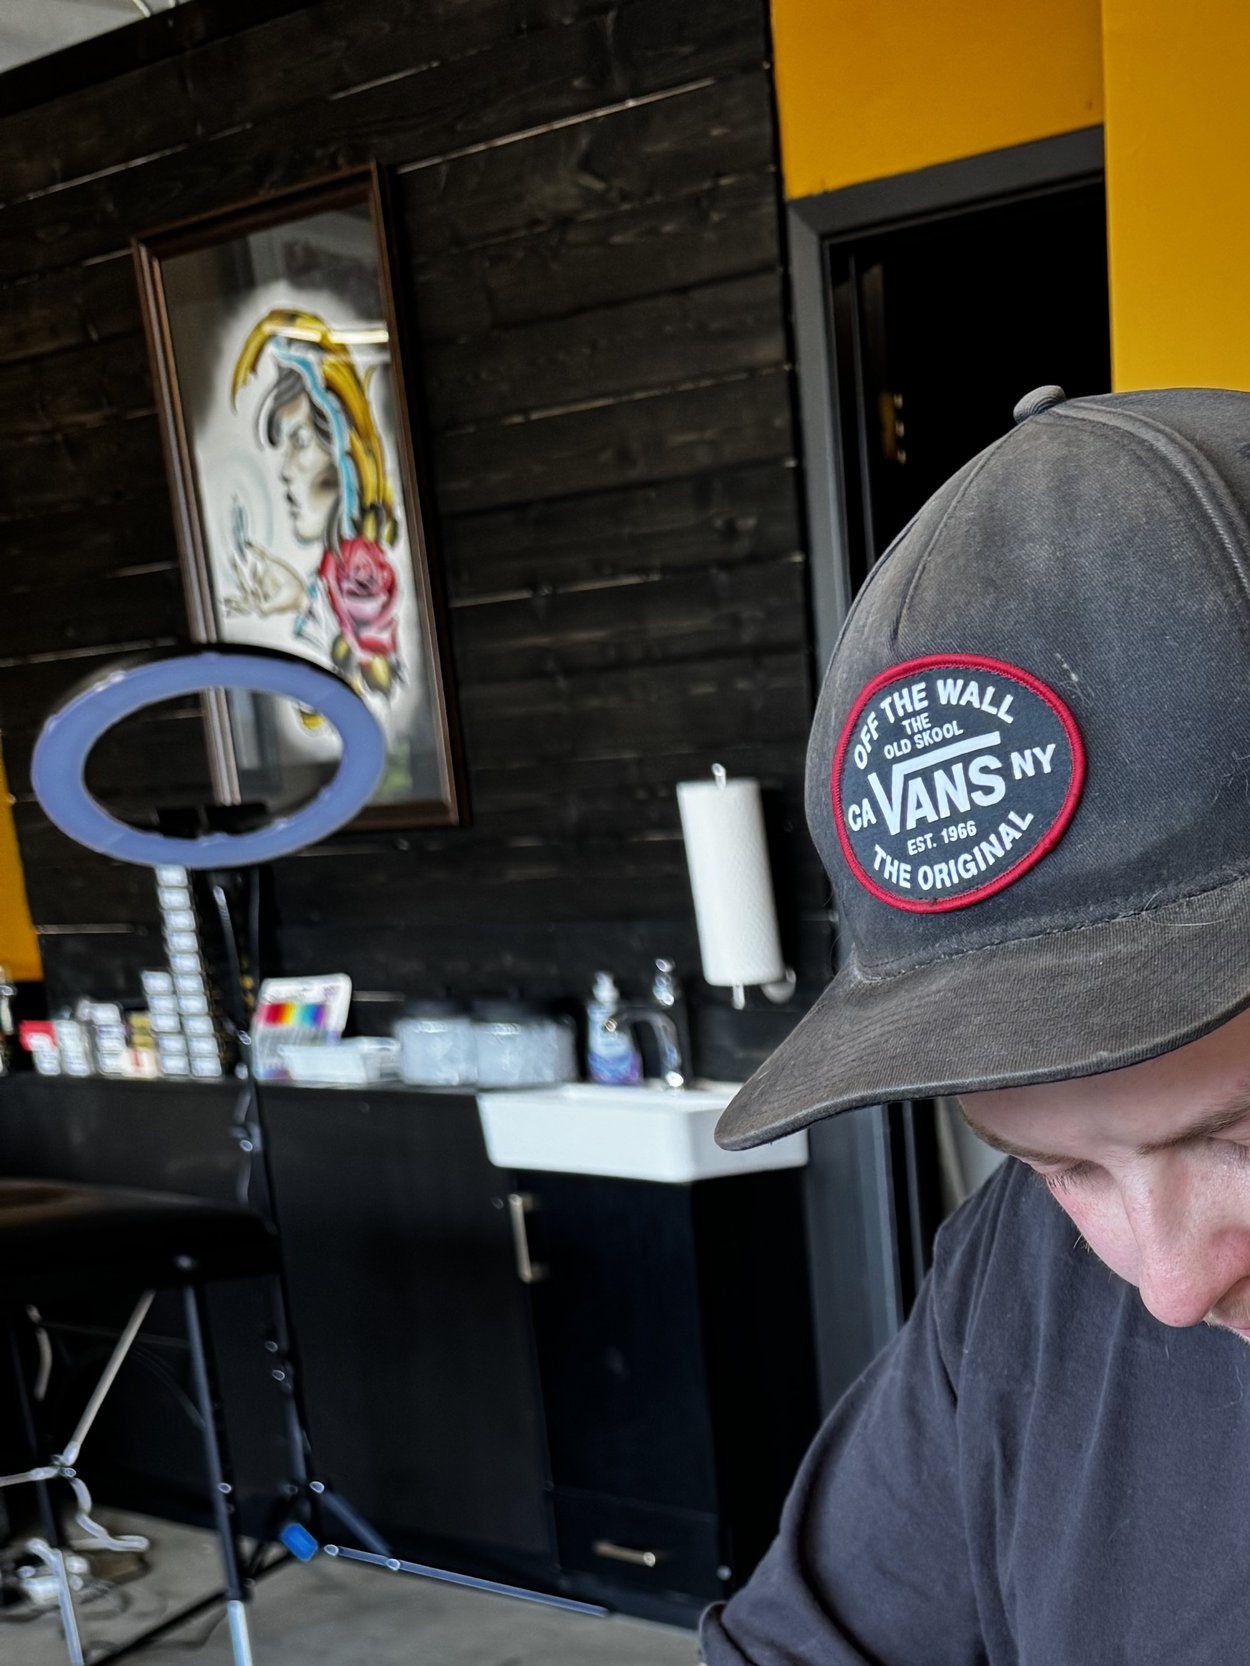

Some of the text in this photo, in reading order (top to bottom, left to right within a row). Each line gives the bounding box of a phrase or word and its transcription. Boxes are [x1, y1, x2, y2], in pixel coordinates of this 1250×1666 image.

[854, 678, 1014, 770] OFF THE WALL
[884, 720, 964, 760] OLD SKOOL
[901, 712, 932, 736] THE
[848, 731, 1056, 836] CA VANS NY
[872, 810, 1034, 890] THE ORIGINAL
[907, 820, 977, 856] EST. 1966
